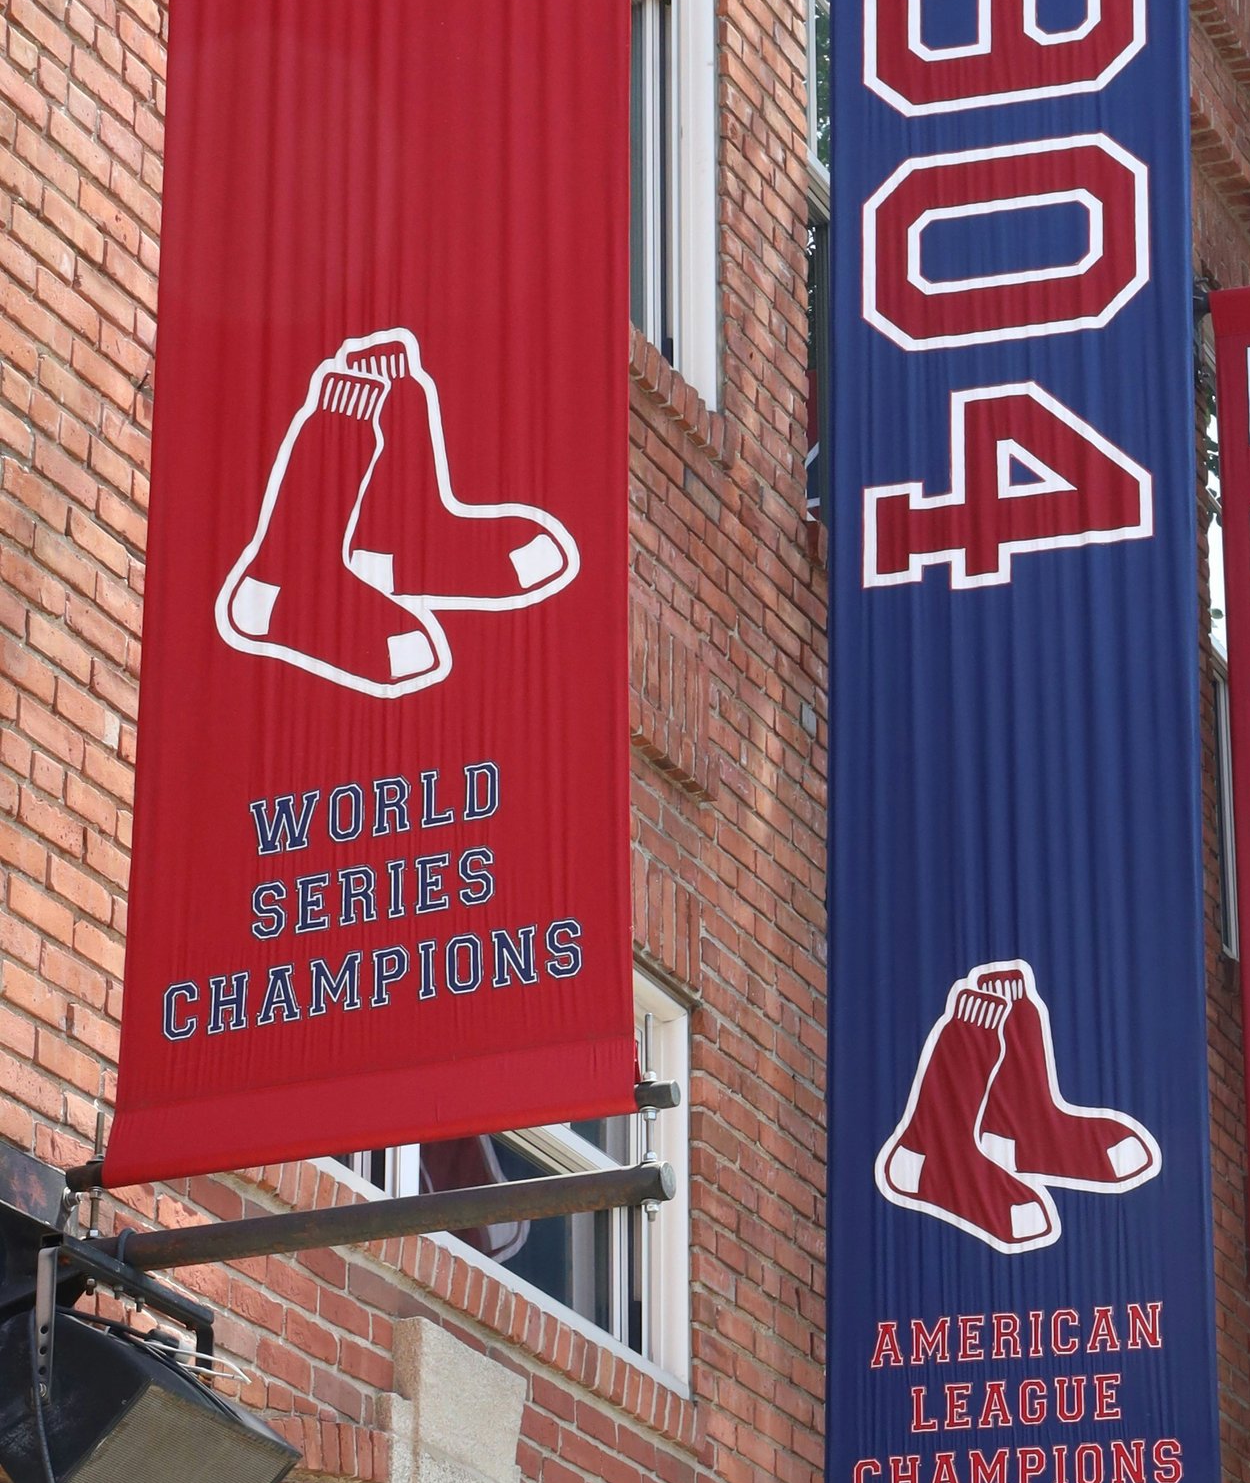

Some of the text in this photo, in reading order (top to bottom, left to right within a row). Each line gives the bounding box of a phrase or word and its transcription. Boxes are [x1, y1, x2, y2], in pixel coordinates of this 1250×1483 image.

[249, 760, 500, 857] WORLD
[250, 846, 495, 941] SERIES
[162, 918, 583, 1042] CHAMPIONS
[871, 1301, 1163, 1369] AMERICAN
[910, 1373, 1122, 1433] LEAGUE
